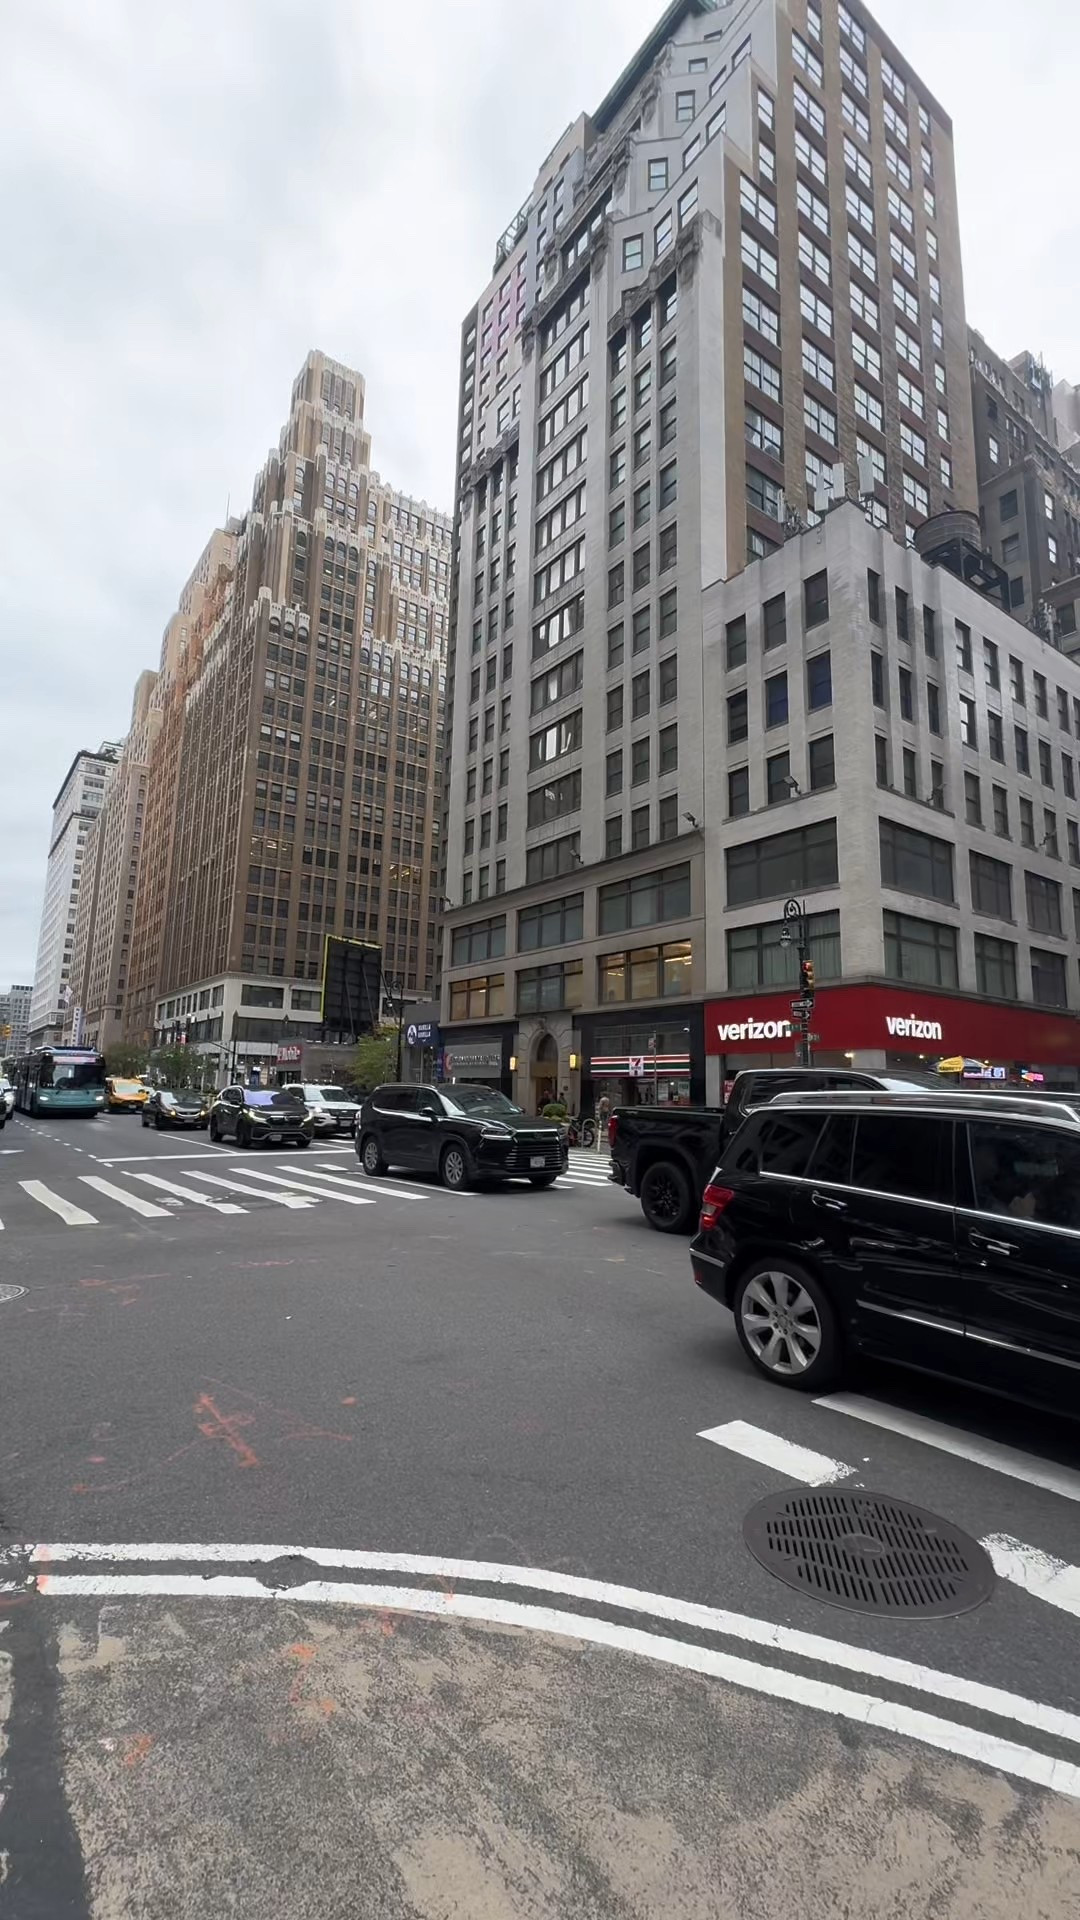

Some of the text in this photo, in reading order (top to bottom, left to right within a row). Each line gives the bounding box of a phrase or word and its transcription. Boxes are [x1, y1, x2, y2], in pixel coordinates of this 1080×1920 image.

[717, 1018, 791, 1040] verizon
[886, 1014, 943, 1040] verizon
[631, 1058, 641, 1067] 7
